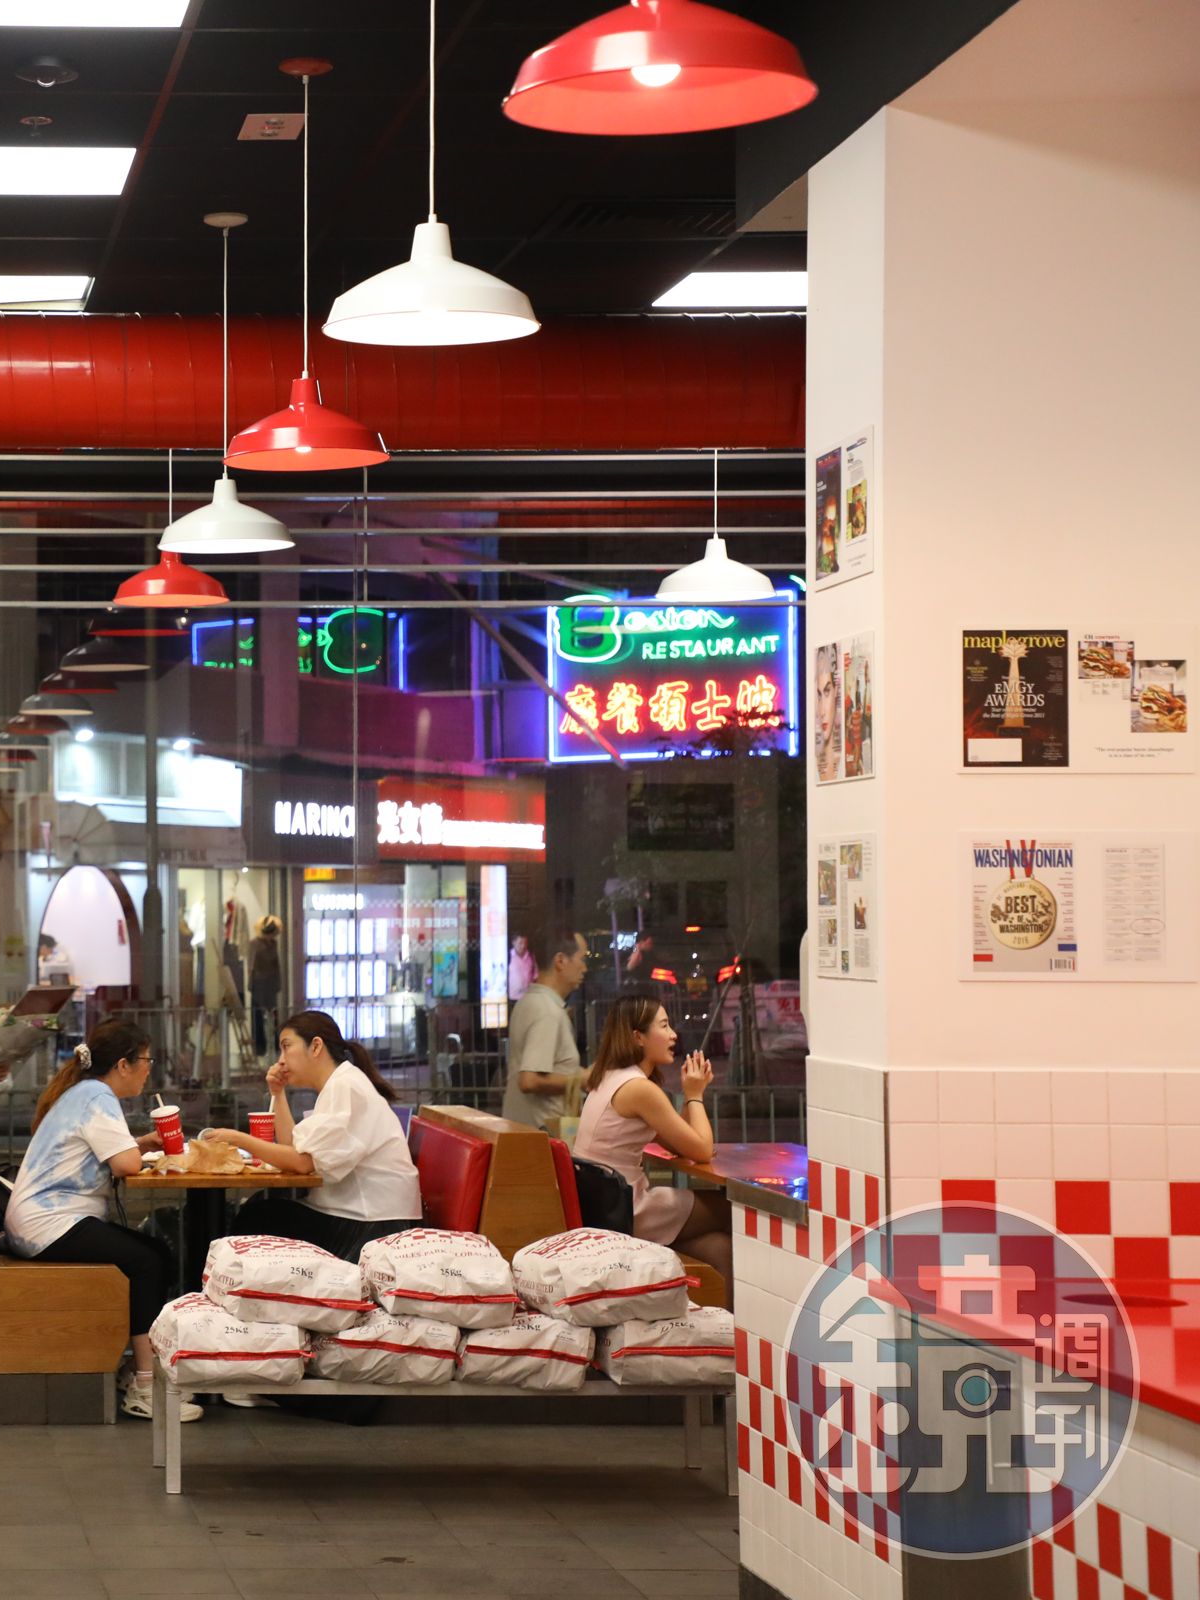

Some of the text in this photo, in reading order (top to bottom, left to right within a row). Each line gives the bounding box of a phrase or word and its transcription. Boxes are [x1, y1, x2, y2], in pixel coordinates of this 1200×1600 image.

[642, 635, 780, 660] RESTAURANT
[984, 694, 1046, 707] AWARDS
[973, 849, 1073, 868] WASHINGTONIAN
[1005, 895, 1037, 913] BEST
[999, 924, 1044, 933] WASHINGTON
[290, 1266, 314, 1279] 25Kg
